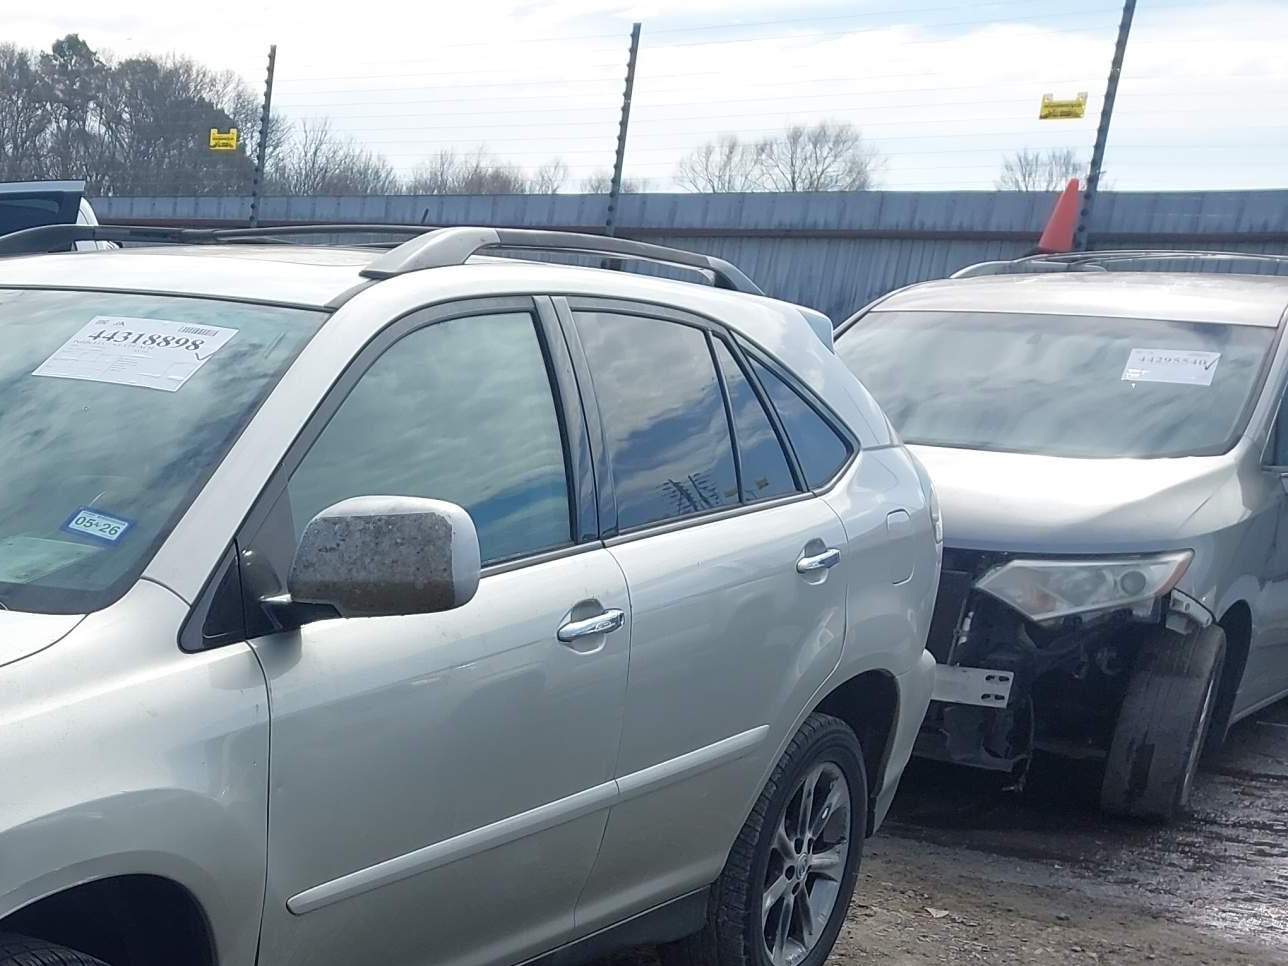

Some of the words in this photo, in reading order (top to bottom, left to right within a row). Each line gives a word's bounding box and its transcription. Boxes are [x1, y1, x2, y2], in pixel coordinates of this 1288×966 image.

[88, 329, 205, 351] 44318898
[75, 517, 96, 528] 05
[99, 523, 121, 536] 26
